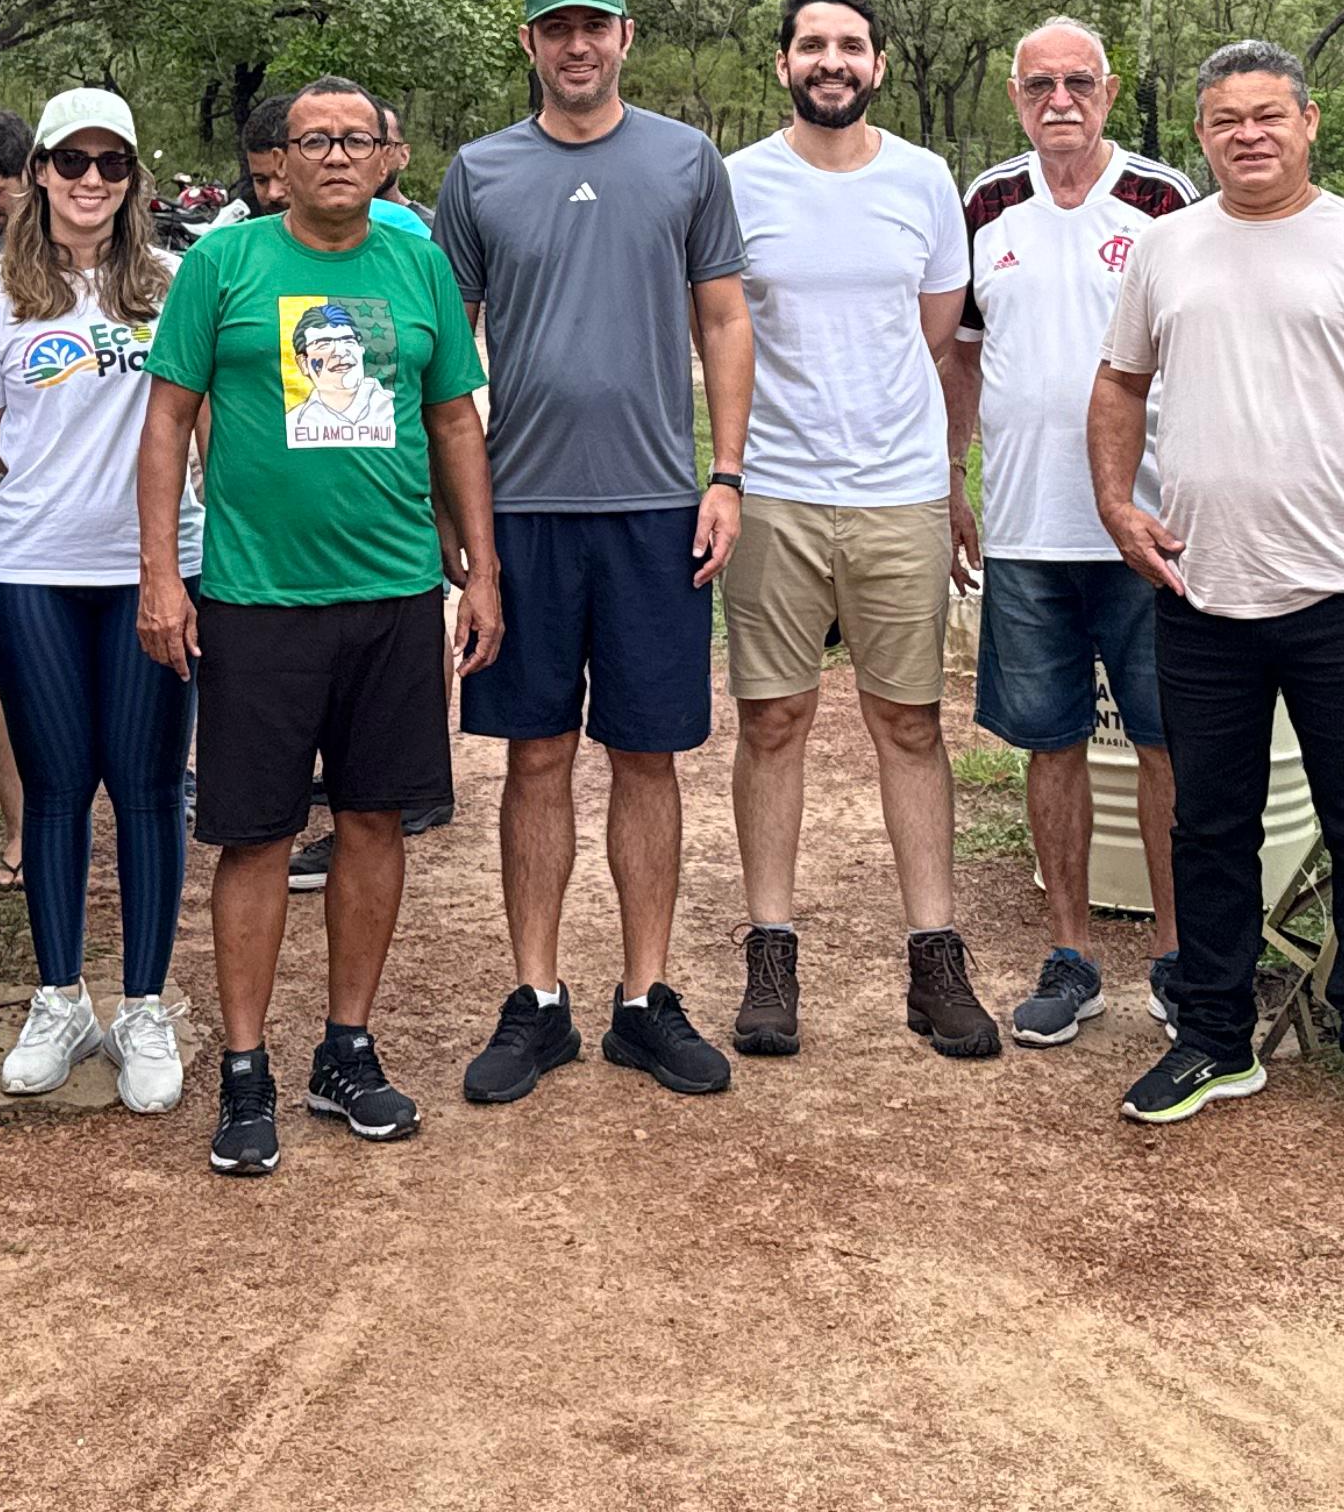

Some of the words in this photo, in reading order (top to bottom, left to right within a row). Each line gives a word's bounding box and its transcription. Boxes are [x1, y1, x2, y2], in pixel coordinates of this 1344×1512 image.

[295, 426, 319, 441] EU
[323, 425, 354, 441] AMO
[1092, 736, 1130, 748] BRASIL
